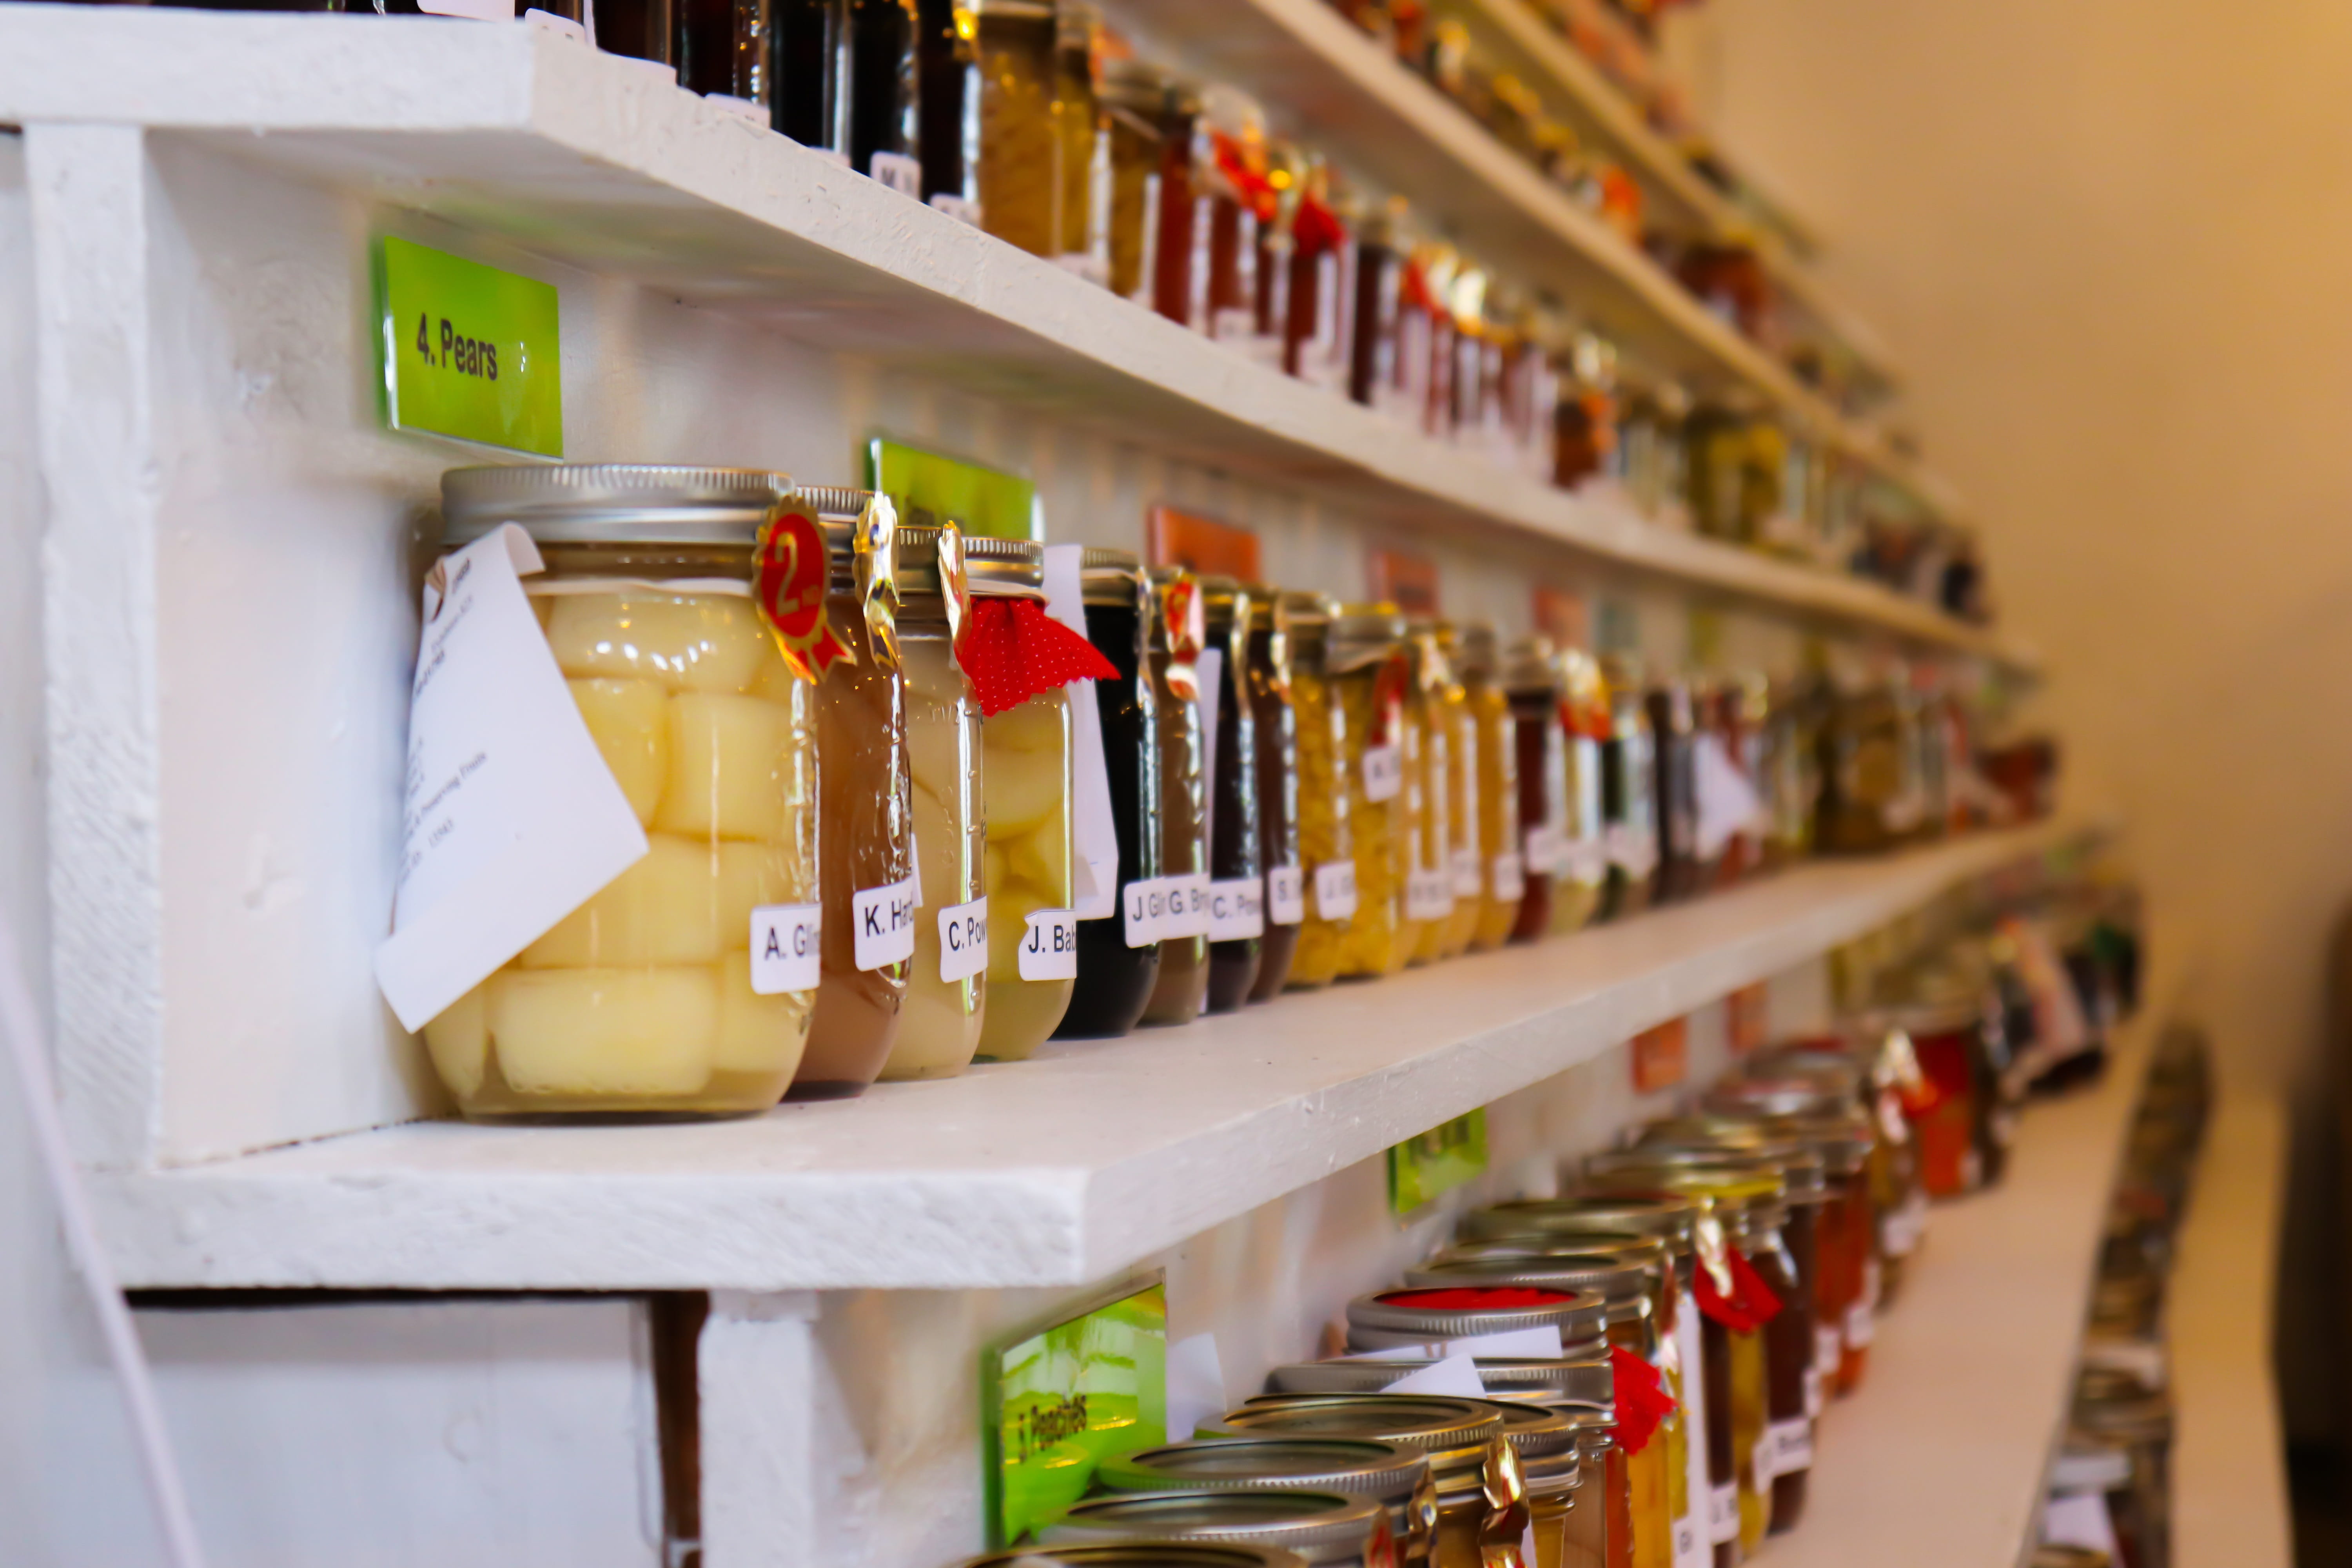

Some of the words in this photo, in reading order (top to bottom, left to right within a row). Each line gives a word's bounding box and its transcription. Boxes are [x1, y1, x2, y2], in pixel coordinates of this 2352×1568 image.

[416, 312, 436, 366] 4.
[440, 318, 498, 381] Pears
[865, 904, 885, 937] K.
[949, 921, 964, 951] C.
[765, 926, 787, 960] A.
[1028, 926, 1045, 953] J.
